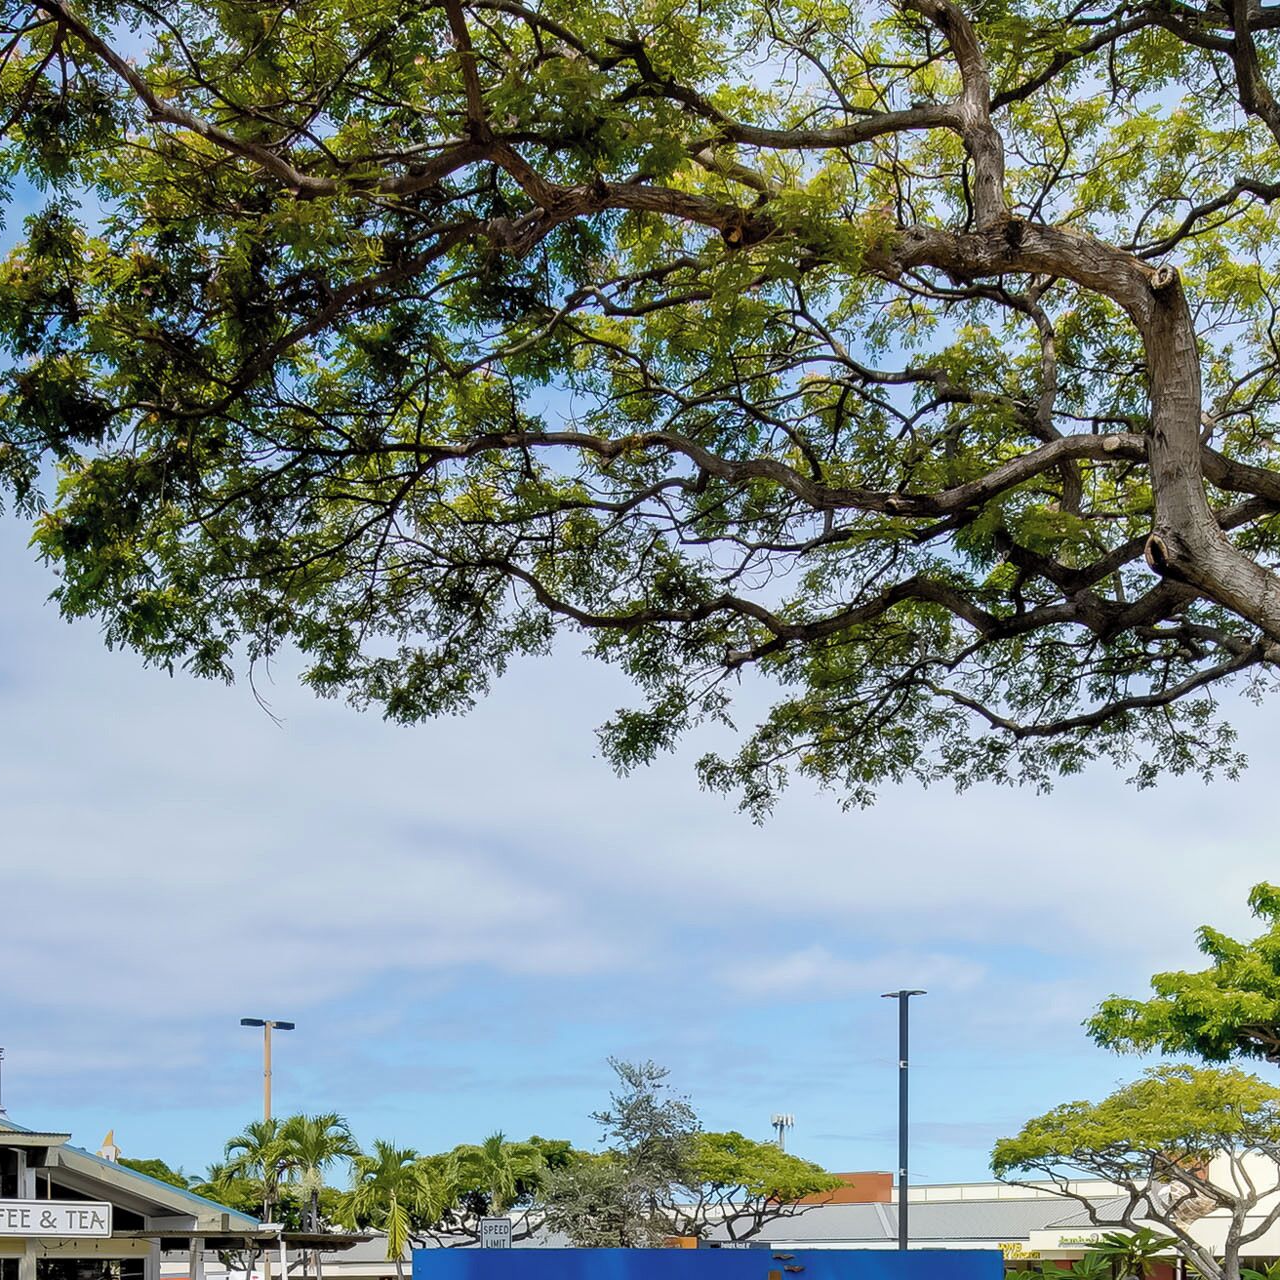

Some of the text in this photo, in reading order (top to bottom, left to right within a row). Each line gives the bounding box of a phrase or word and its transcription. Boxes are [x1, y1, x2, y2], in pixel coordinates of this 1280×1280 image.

[40, 1210, 57, 1229] &
[65, 1209, 106, 1230] TEA
[483, 1224, 509, 1235] SPEED
[485, 1239, 506, 1249] LIMIT
